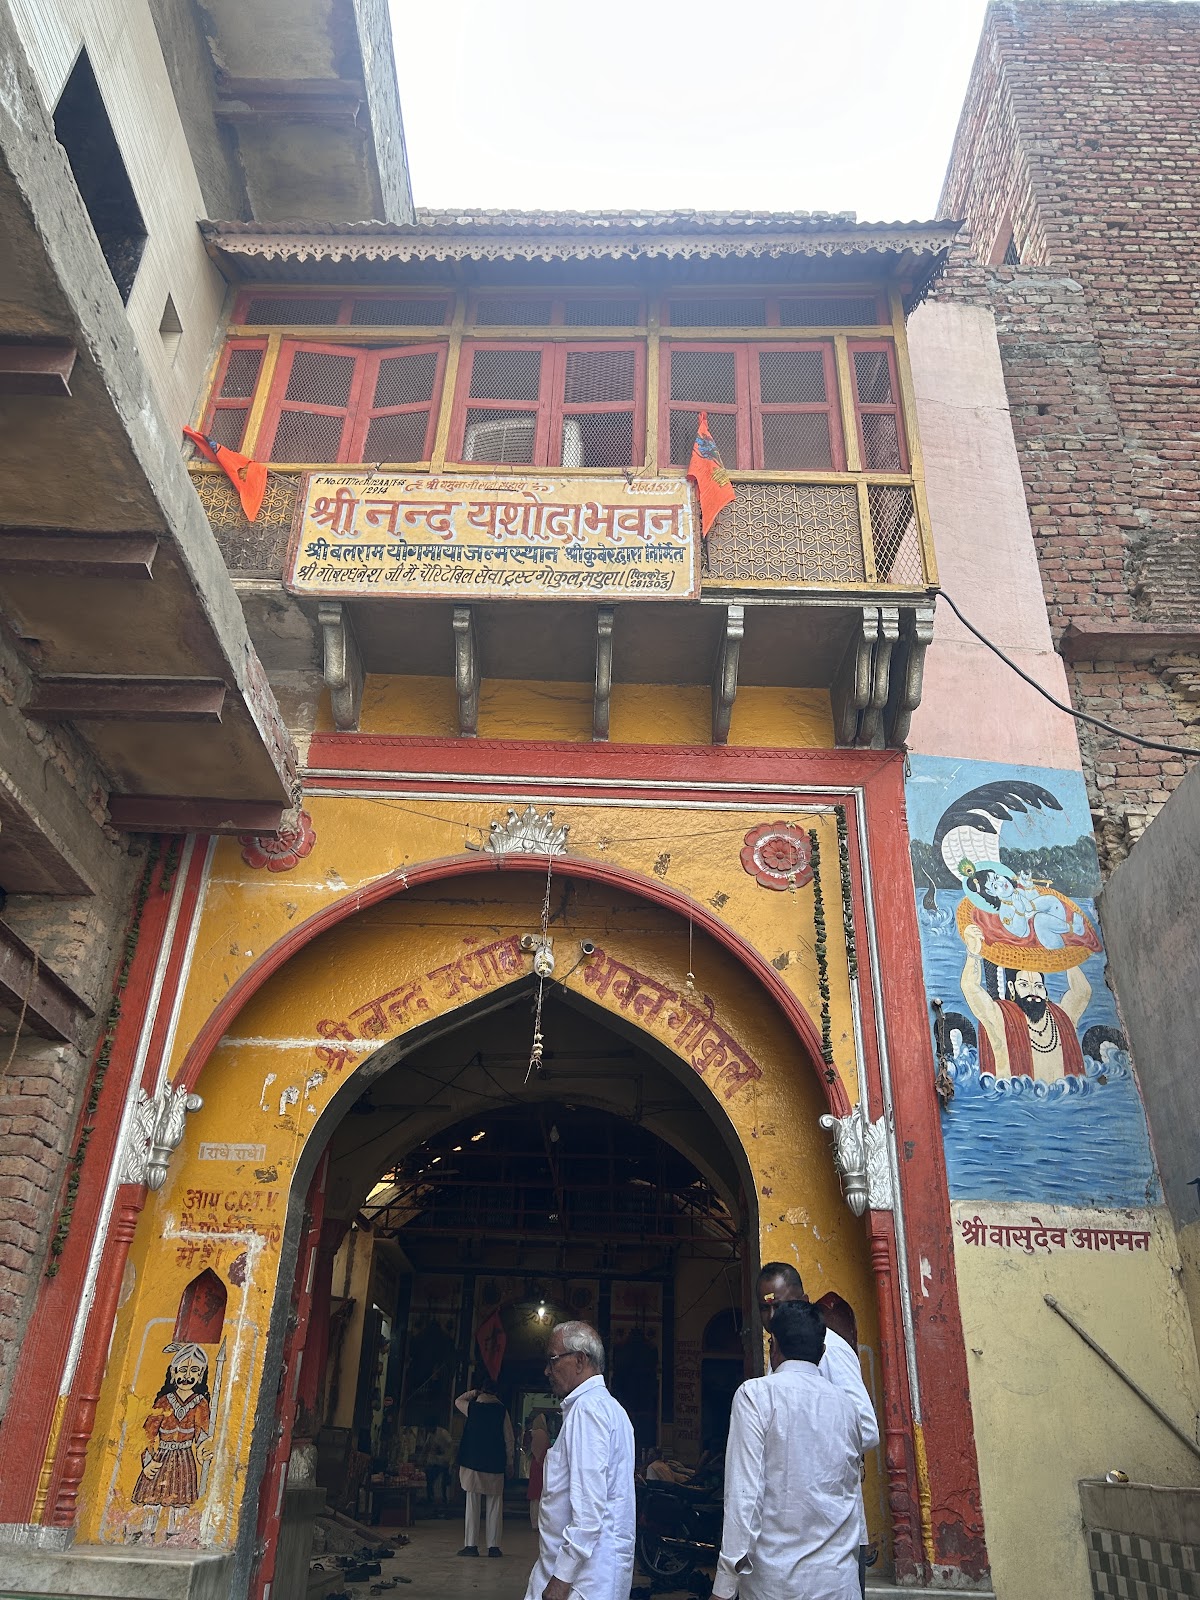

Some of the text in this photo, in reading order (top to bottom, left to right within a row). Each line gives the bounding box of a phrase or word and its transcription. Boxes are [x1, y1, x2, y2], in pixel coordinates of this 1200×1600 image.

[310, 487, 360, 536] श्री
[364, 499, 462, 541] नन्द
[467, 491, 585, 543] यशोदा
[305, 537, 331, 561] श्री
[329, 543, 386, 563] बलराम
[386, 538, 465, 563] योगमाया
[297, 562, 319, 582] श्री
[473, 565, 507, 585] सेवा
[989, 1216, 1067, 1254] वासुदेव
[1071, 1228, 1150, 1251] आगमन
